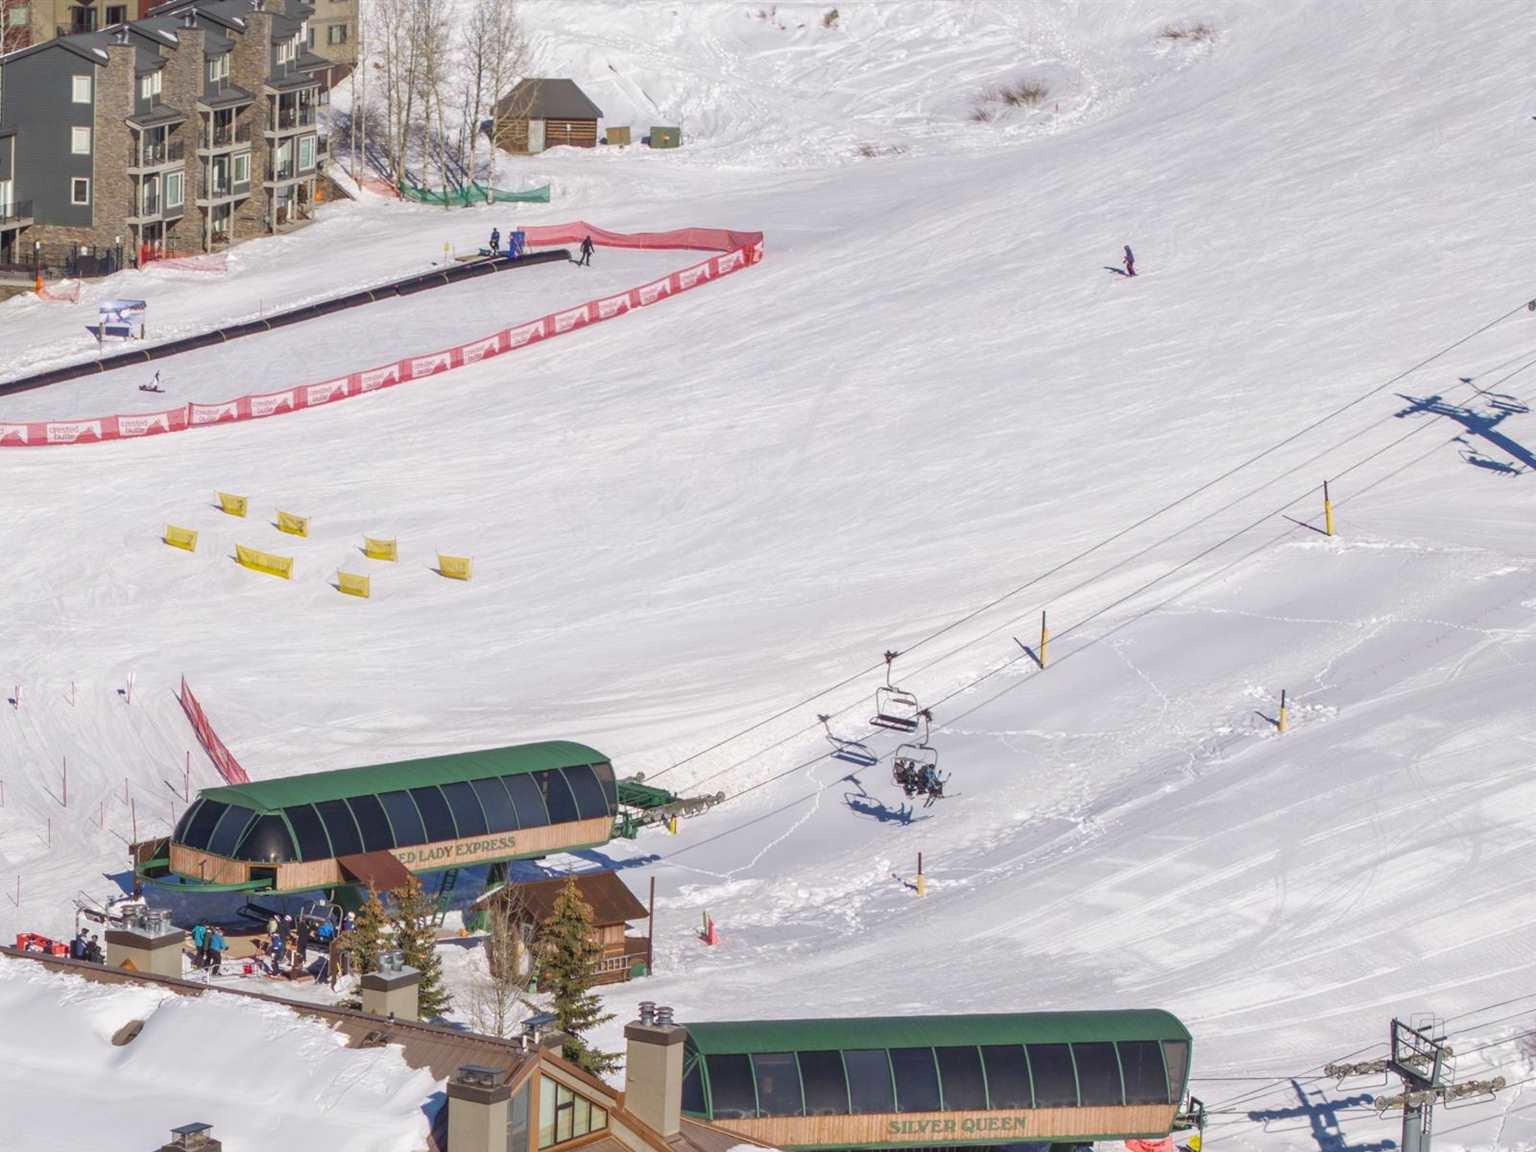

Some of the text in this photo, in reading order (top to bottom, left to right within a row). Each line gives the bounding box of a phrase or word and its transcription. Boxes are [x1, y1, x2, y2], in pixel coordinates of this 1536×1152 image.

[396, 836, 516, 864] ED LADY EXPRESS
[890, 1116, 1027, 1134] SILVER QUEEN
